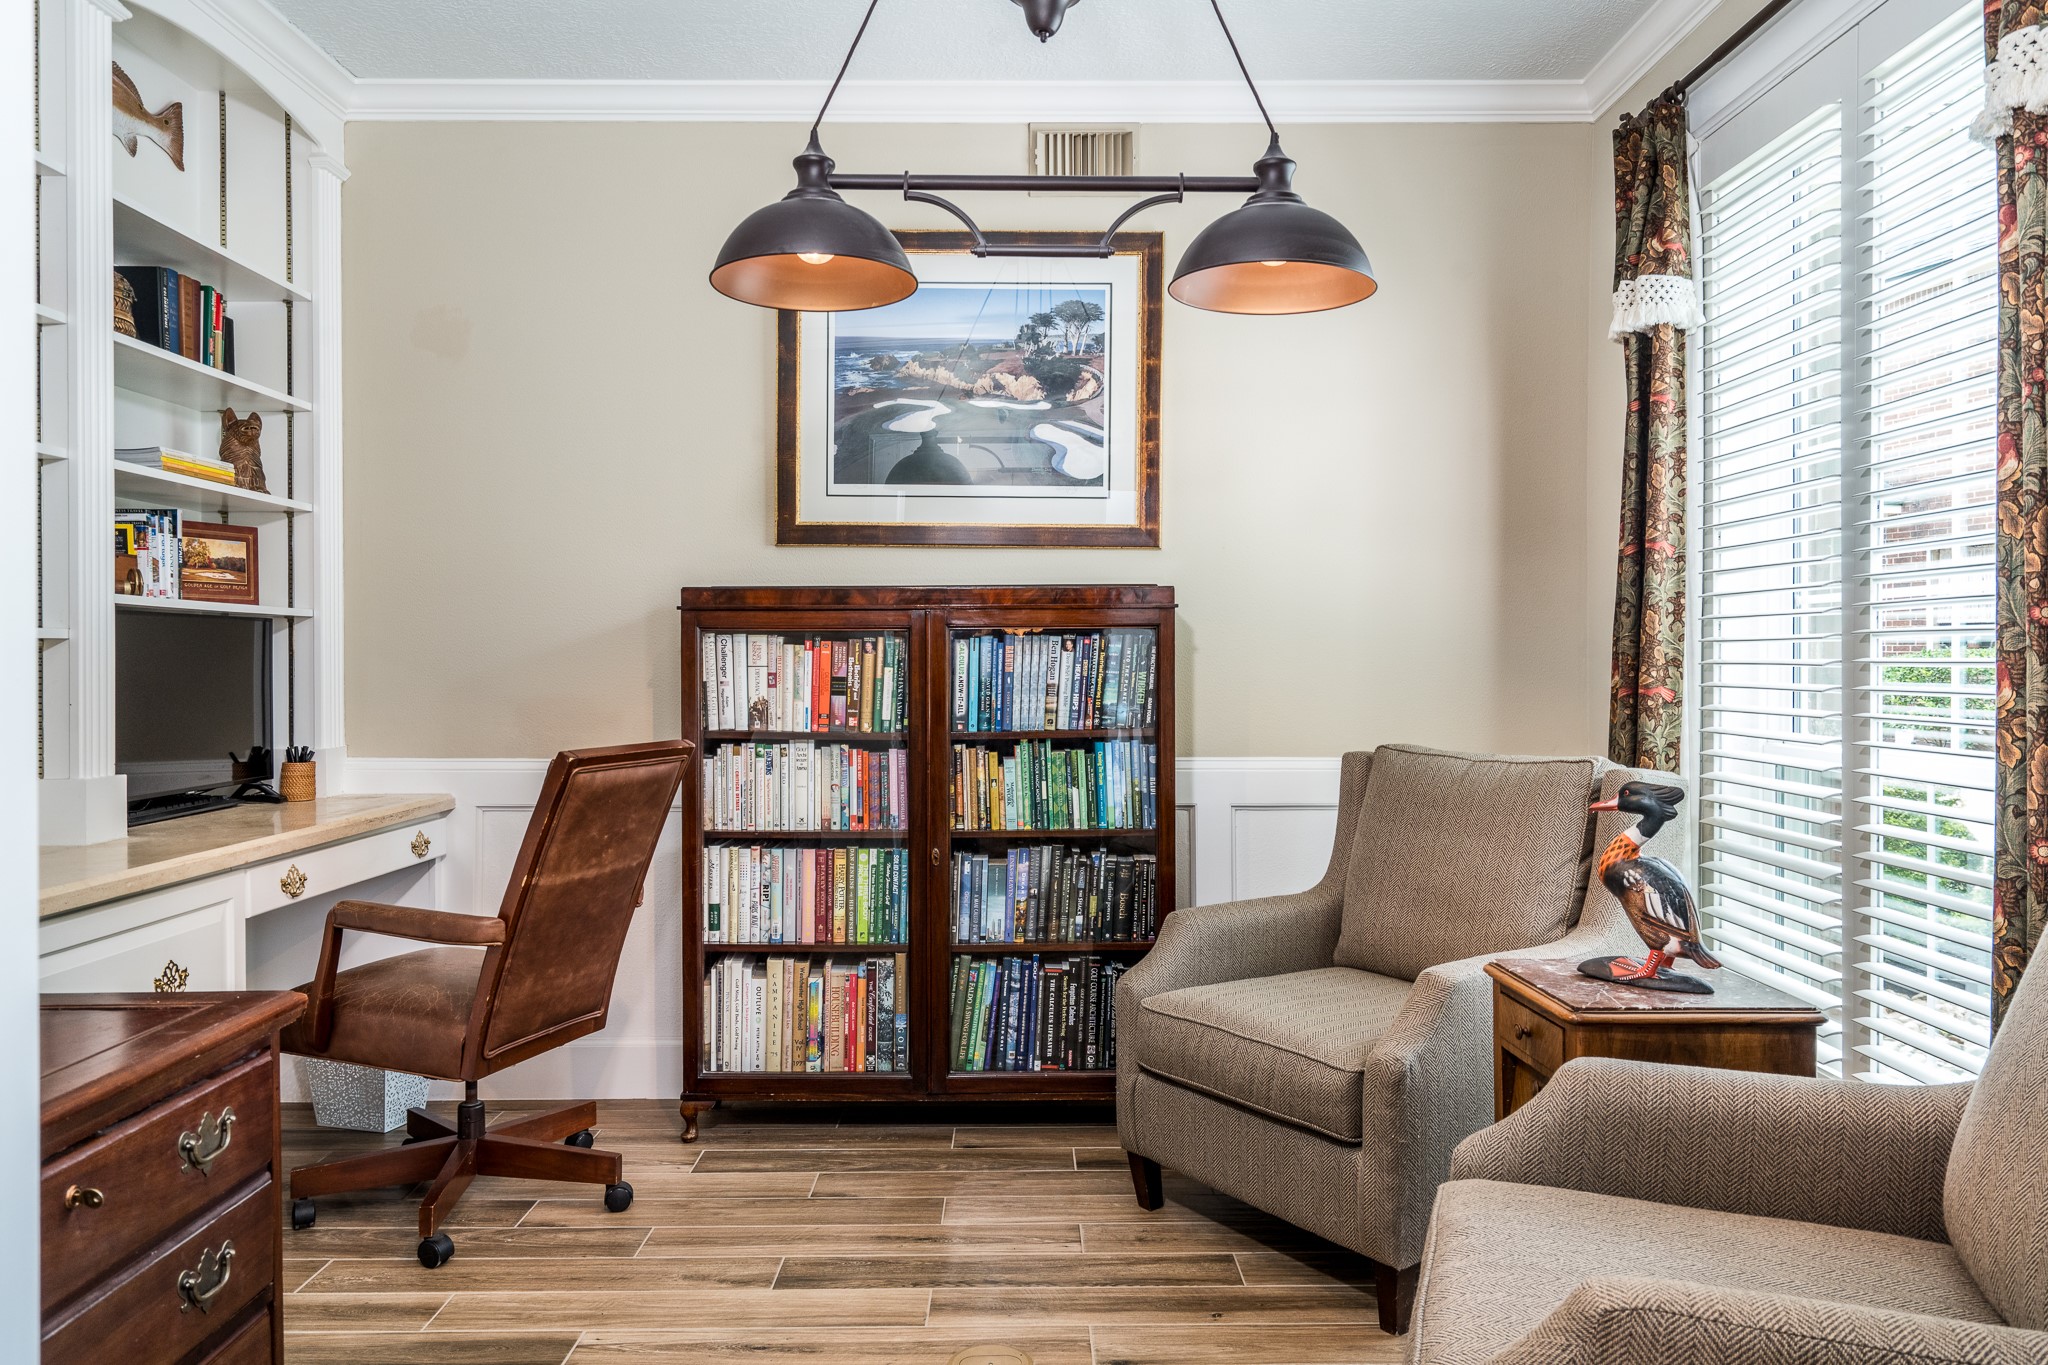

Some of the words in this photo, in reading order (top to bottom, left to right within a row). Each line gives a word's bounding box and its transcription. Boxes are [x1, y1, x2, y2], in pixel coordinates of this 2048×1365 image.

[720, 638, 728, 678] Challenger
[1049, 656, 1058, 680] Hogan
[1137, 672, 1147, 704] WICKED
[1119, 892, 1128, 919] Bosch
[1069, 983, 1077, 1005] Forgotten
[831, 986, 840, 1056] HOUSEBUILDING
[963, 1011, 971, 1032] SWING
